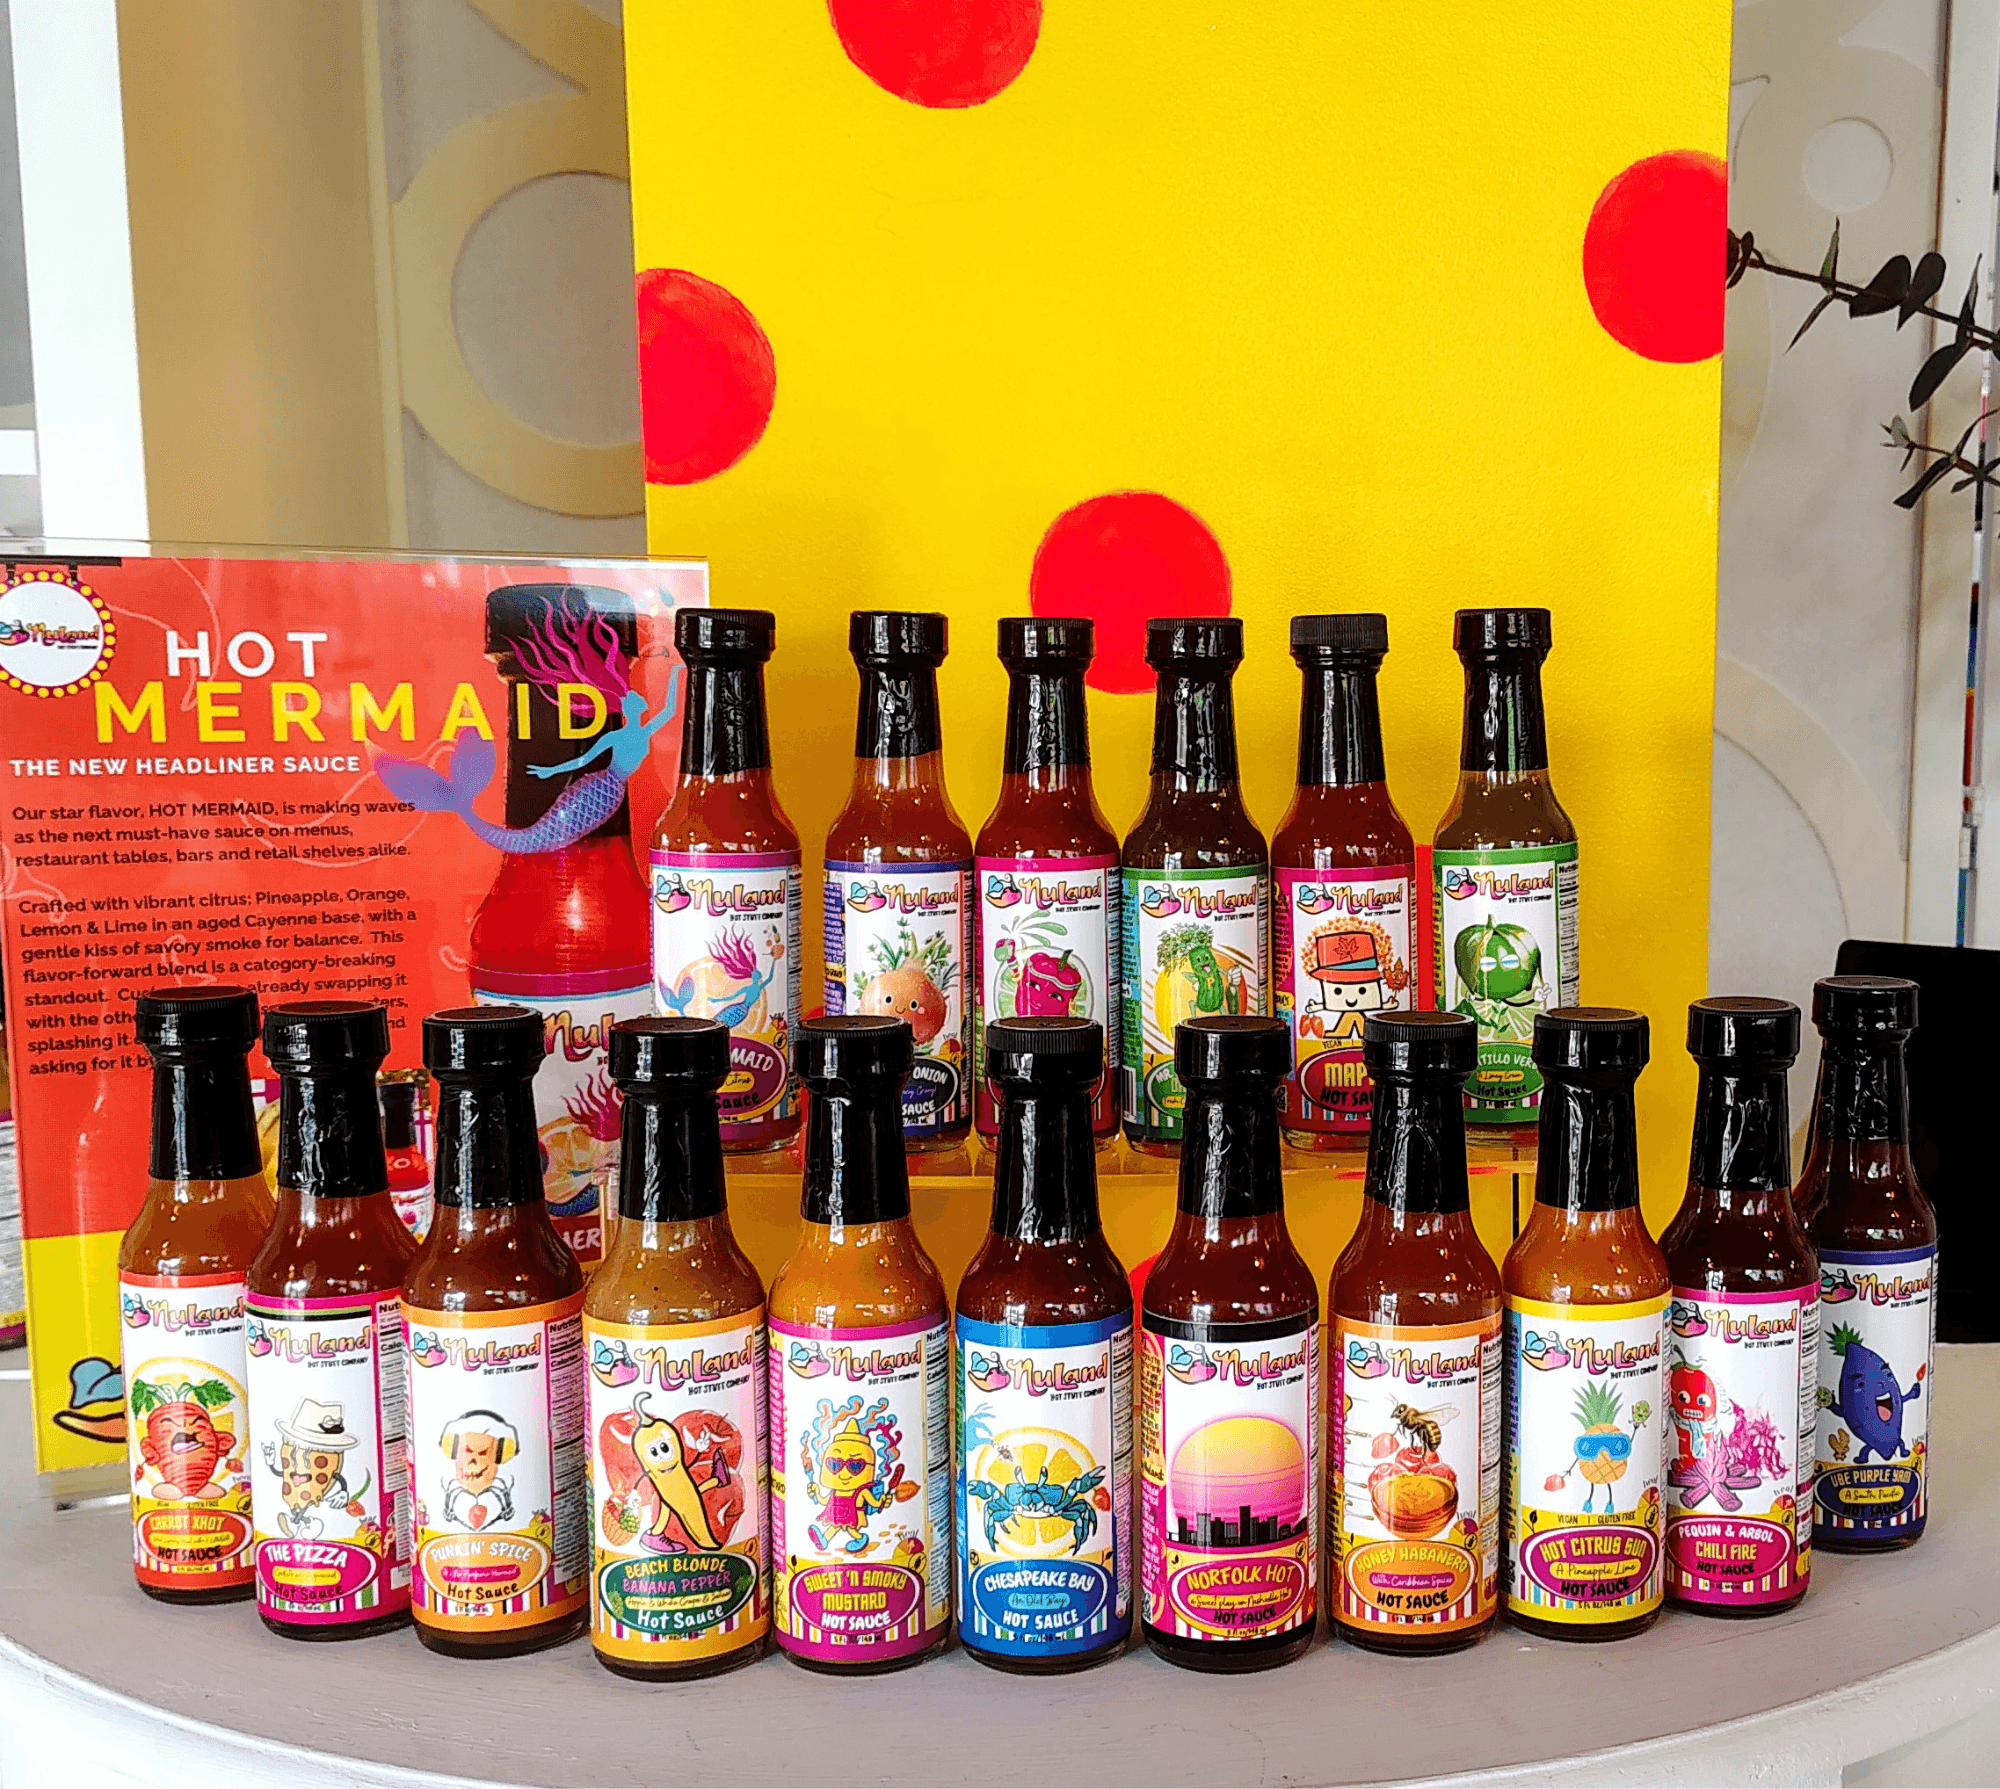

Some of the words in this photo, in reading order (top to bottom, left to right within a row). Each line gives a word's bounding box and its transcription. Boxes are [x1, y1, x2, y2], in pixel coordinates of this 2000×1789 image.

[166, 630, 328, 678] HOT
[94, 681, 607, 743] MERMAID
[9, 759, 61, 777] THE
[69, 759, 127, 776] NEW
[136, 757, 274, 775] HEADLINER
[282, 756, 361, 773] SAUCE
[12, 807, 45, 820] Our
[50, 807, 83, 819] star
[89, 805, 144, 820] flavor,
[149, 805, 186, 817] HOT
[192, 803, 278, 818] MERMAID,
[283, 802, 295, 814] is
[301, 801, 360, 816] making
[365, 802, 415, 813] waves
[14, 833, 34, 843] as
[39, 829, 68, 842] the
[73, 829, 112, 842] next
[116, 827, 209, 841] must-have
[214, 827, 264, 838] sauce
[269, 827, 289, 837] on
[294, 824, 353, 838] menus,
[16, 853, 109, 867] restaurant
[114, 850, 172, 864] tables,
[177, 849, 213, 862] bars
[219, 847, 250, 860] and
[255, 846, 298, 859] retail
[303, 844, 364, 857] shelves
[369, 843, 410, 856] alike.
[19, 899, 86, 913] Crafted
[91, 897, 129, 911] with
[134, 895, 195, 909] vibrant
[256, 890, 344, 906] Pineapple,
[347, 888, 410, 904] Orange,
[21, 923, 81, 937] Lemon
[87, 922, 99, 934] &
[104, 920, 147, 934] Lime
[152, 919, 167, 932] in
[172, 919, 192, 930] an
[197, 916, 240, 933] aged
[245, 913, 317, 930] Cayenne
[322, 911, 364, 924] base,
[368, 910, 403, 922] with
[407, 911, 416, 921] a
[22, 944, 79, 962] gentle
[85, 943, 117, 957] kiss
[122, 941, 140, 955] of
[144, 941, 200, 956] savory
[205, 937, 261, 951] smoke
[266, 935, 289, 948] for
[294, 933, 362, 947] balance.
[371, 930, 404, 943] This
[24, 964, 152, 982] flavor-forward
[157, 961, 206, 976] blend
[212, 960, 224, 974] is
[229, 963, 239, 973] a
[243, 953, 395, 974] category-breaking
[25, 990, 108, 1005] standout.
[248, 981, 309, 995] already
[314, 977, 393, 993] swapping
[397, 974, 407, 986] it
[26, 1015, 65, 1029] with
[70, 1013, 98, 1026] the
[28, 1034, 112, 1052] splashing
[117, 1034, 131, 1046] it
[30, 1060, 86, 1075] asking
[91, 1057, 117, 1070] for
[122, 1057, 133, 1069] it
[912, 1066, 949, 1085] ONION
[1320, 1087, 1348, 1106] HOT
[901, 1099, 936, 1116] SAUCE
[1830, 1471, 1852, 1487] UBE
[1853, 1469, 1891, 1484] PURPLE
[1557, 1515, 1579, 1524] VEGAN
[1597, 1514, 1620, 1524] GLUTEN
[1621, 1512, 1636, 1523] FREE
[1678, 1524, 1722, 1538] PEQUIN
[1724, 1525, 1735, 1536] &
[1738, 1525, 1775, 1543] ARBOL
[158, 1547, 179, 1561] HOT
[181, 1545, 222, 1561] SAUCE
[265, 1543, 291, 1563] THE
[292, 1543, 348, 1569] PIZZA
[489, 1542, 533, 1562] SPICE
[1539, 1539, 1567, 1563] HOT
[1570, 1536, 1622, 1557] CITRUS
[1695, 1541, 1727, 1558] CHILI
[1730, 1543, 1758, 1560] FIRE
[624, 1557, 669, 1580] BEACH
[673, 1557, 728, 1574] BLONDE
[1355, 1549, 1396, 1573] HONEY
[1399, 1547, 1468, 1573] HABANERO
[1556, 1563, 1564, 1575] A
[1697, 1561, 1717, 1575] HOT
[1719, 1562, 1755, 1575] SAUCE
[622, 1578, 677, 1593] BANANA
[681, 1571, 732, 1592] PEPPER
[803, 1571, 843, 1593] SWEET
[862, 1570, 909, 1590] SMOKY
[983, 1570, 1067, 1592] CHESAPEAKE
[1068, 1571, 1096, 1591] BAY
[1186, 1565, 1263, 1591] NORFOLK
[1265, 1563, 1296, 1583] HOT
[275, 1581, 296, 1599] Hot
[300, 1584, 343, 1601] Sauce
[447, 1584, 472, 1599] Hot
[475, 1582, 519, 1600] Sauce
[1561, 1580, 1588, 1595] HOT
[1590, 1577, 1631, 1598] SAUCE
[822, 1591, 887, 1611] MUSTARD
[1376, 1591, 1404, 1608] HOT
[1406, 1589, 1449, 1609] SAUCE
[637, 1610, 670, 1630] Hot
[673, 1605, 725, 1629] Sauce
[820, 1611, 846, 1629] HOT
[848, 1610, 892, 1631] SAUCE
[1002, 1610, 1030, 1629] HOT
[1034, 1608, 1080, 1629] SAUCE
[1213, 1609, 1239, 1625] HOT
[1240, 1605, 1277, 1625] SAUCE
